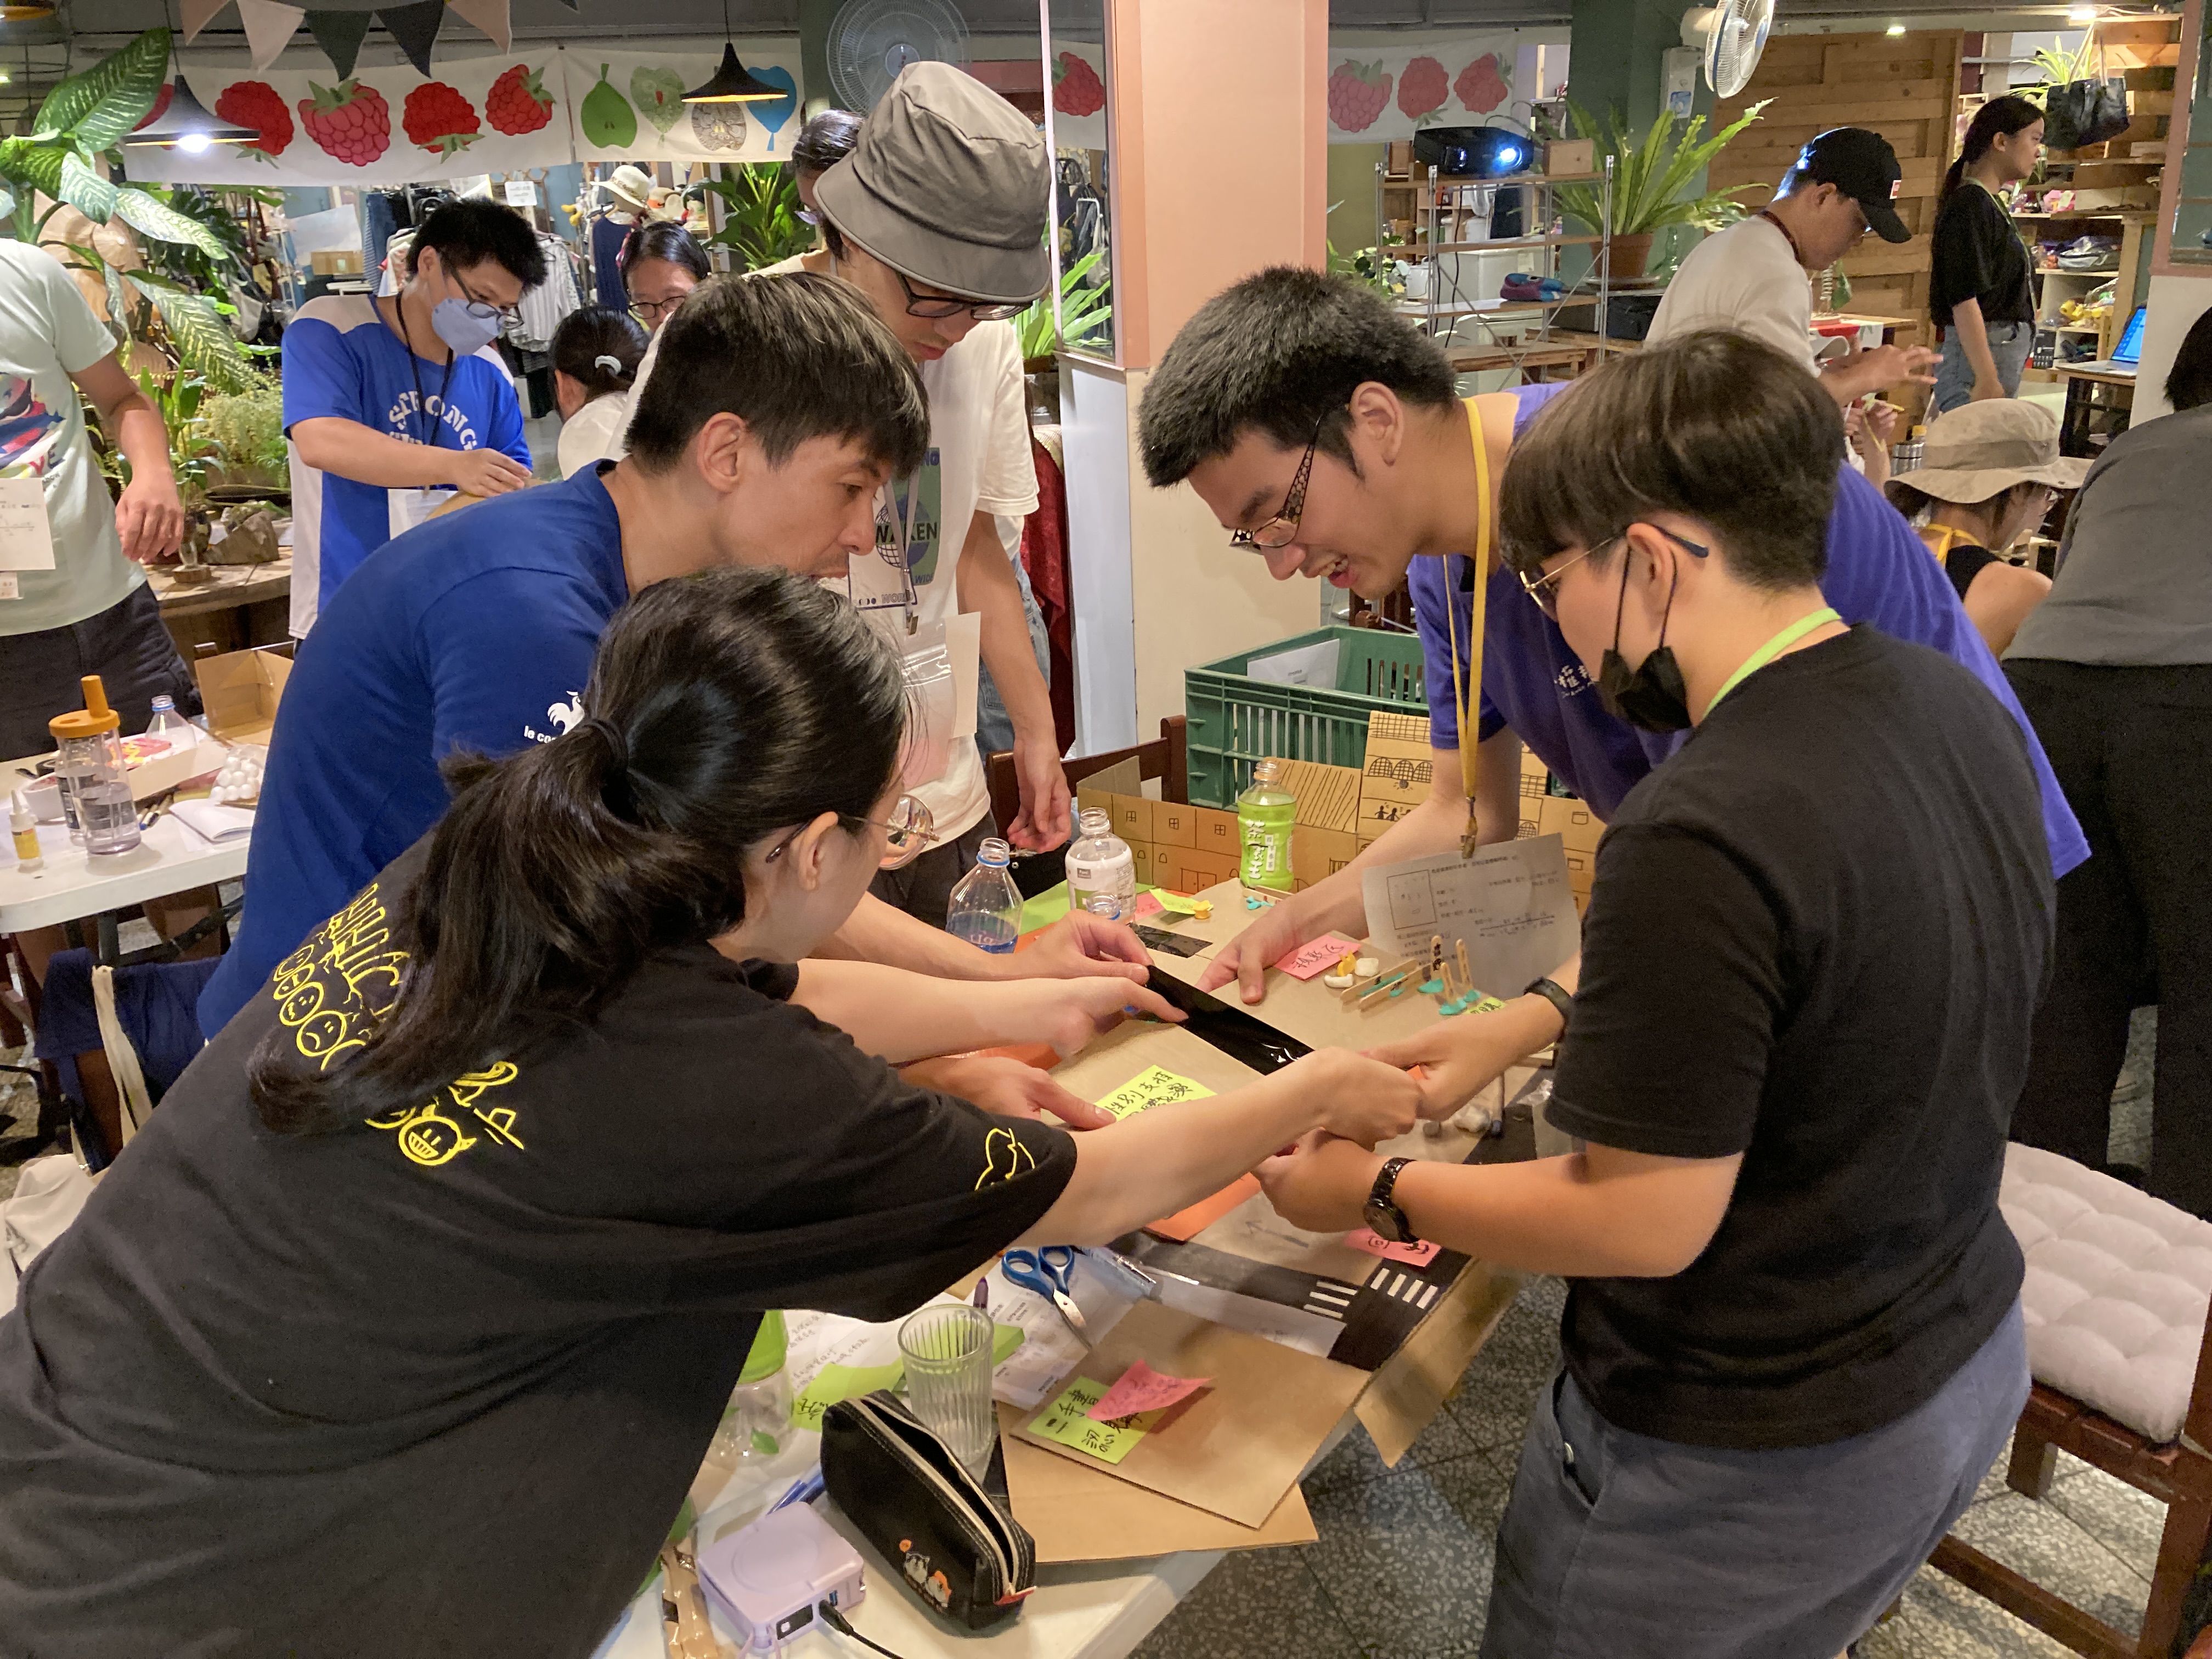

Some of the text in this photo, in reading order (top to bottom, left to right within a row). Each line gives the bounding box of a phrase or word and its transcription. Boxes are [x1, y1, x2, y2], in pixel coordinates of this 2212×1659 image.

[876, 522, 937, 543] WEN
[524, 725, 557, 743] le co
